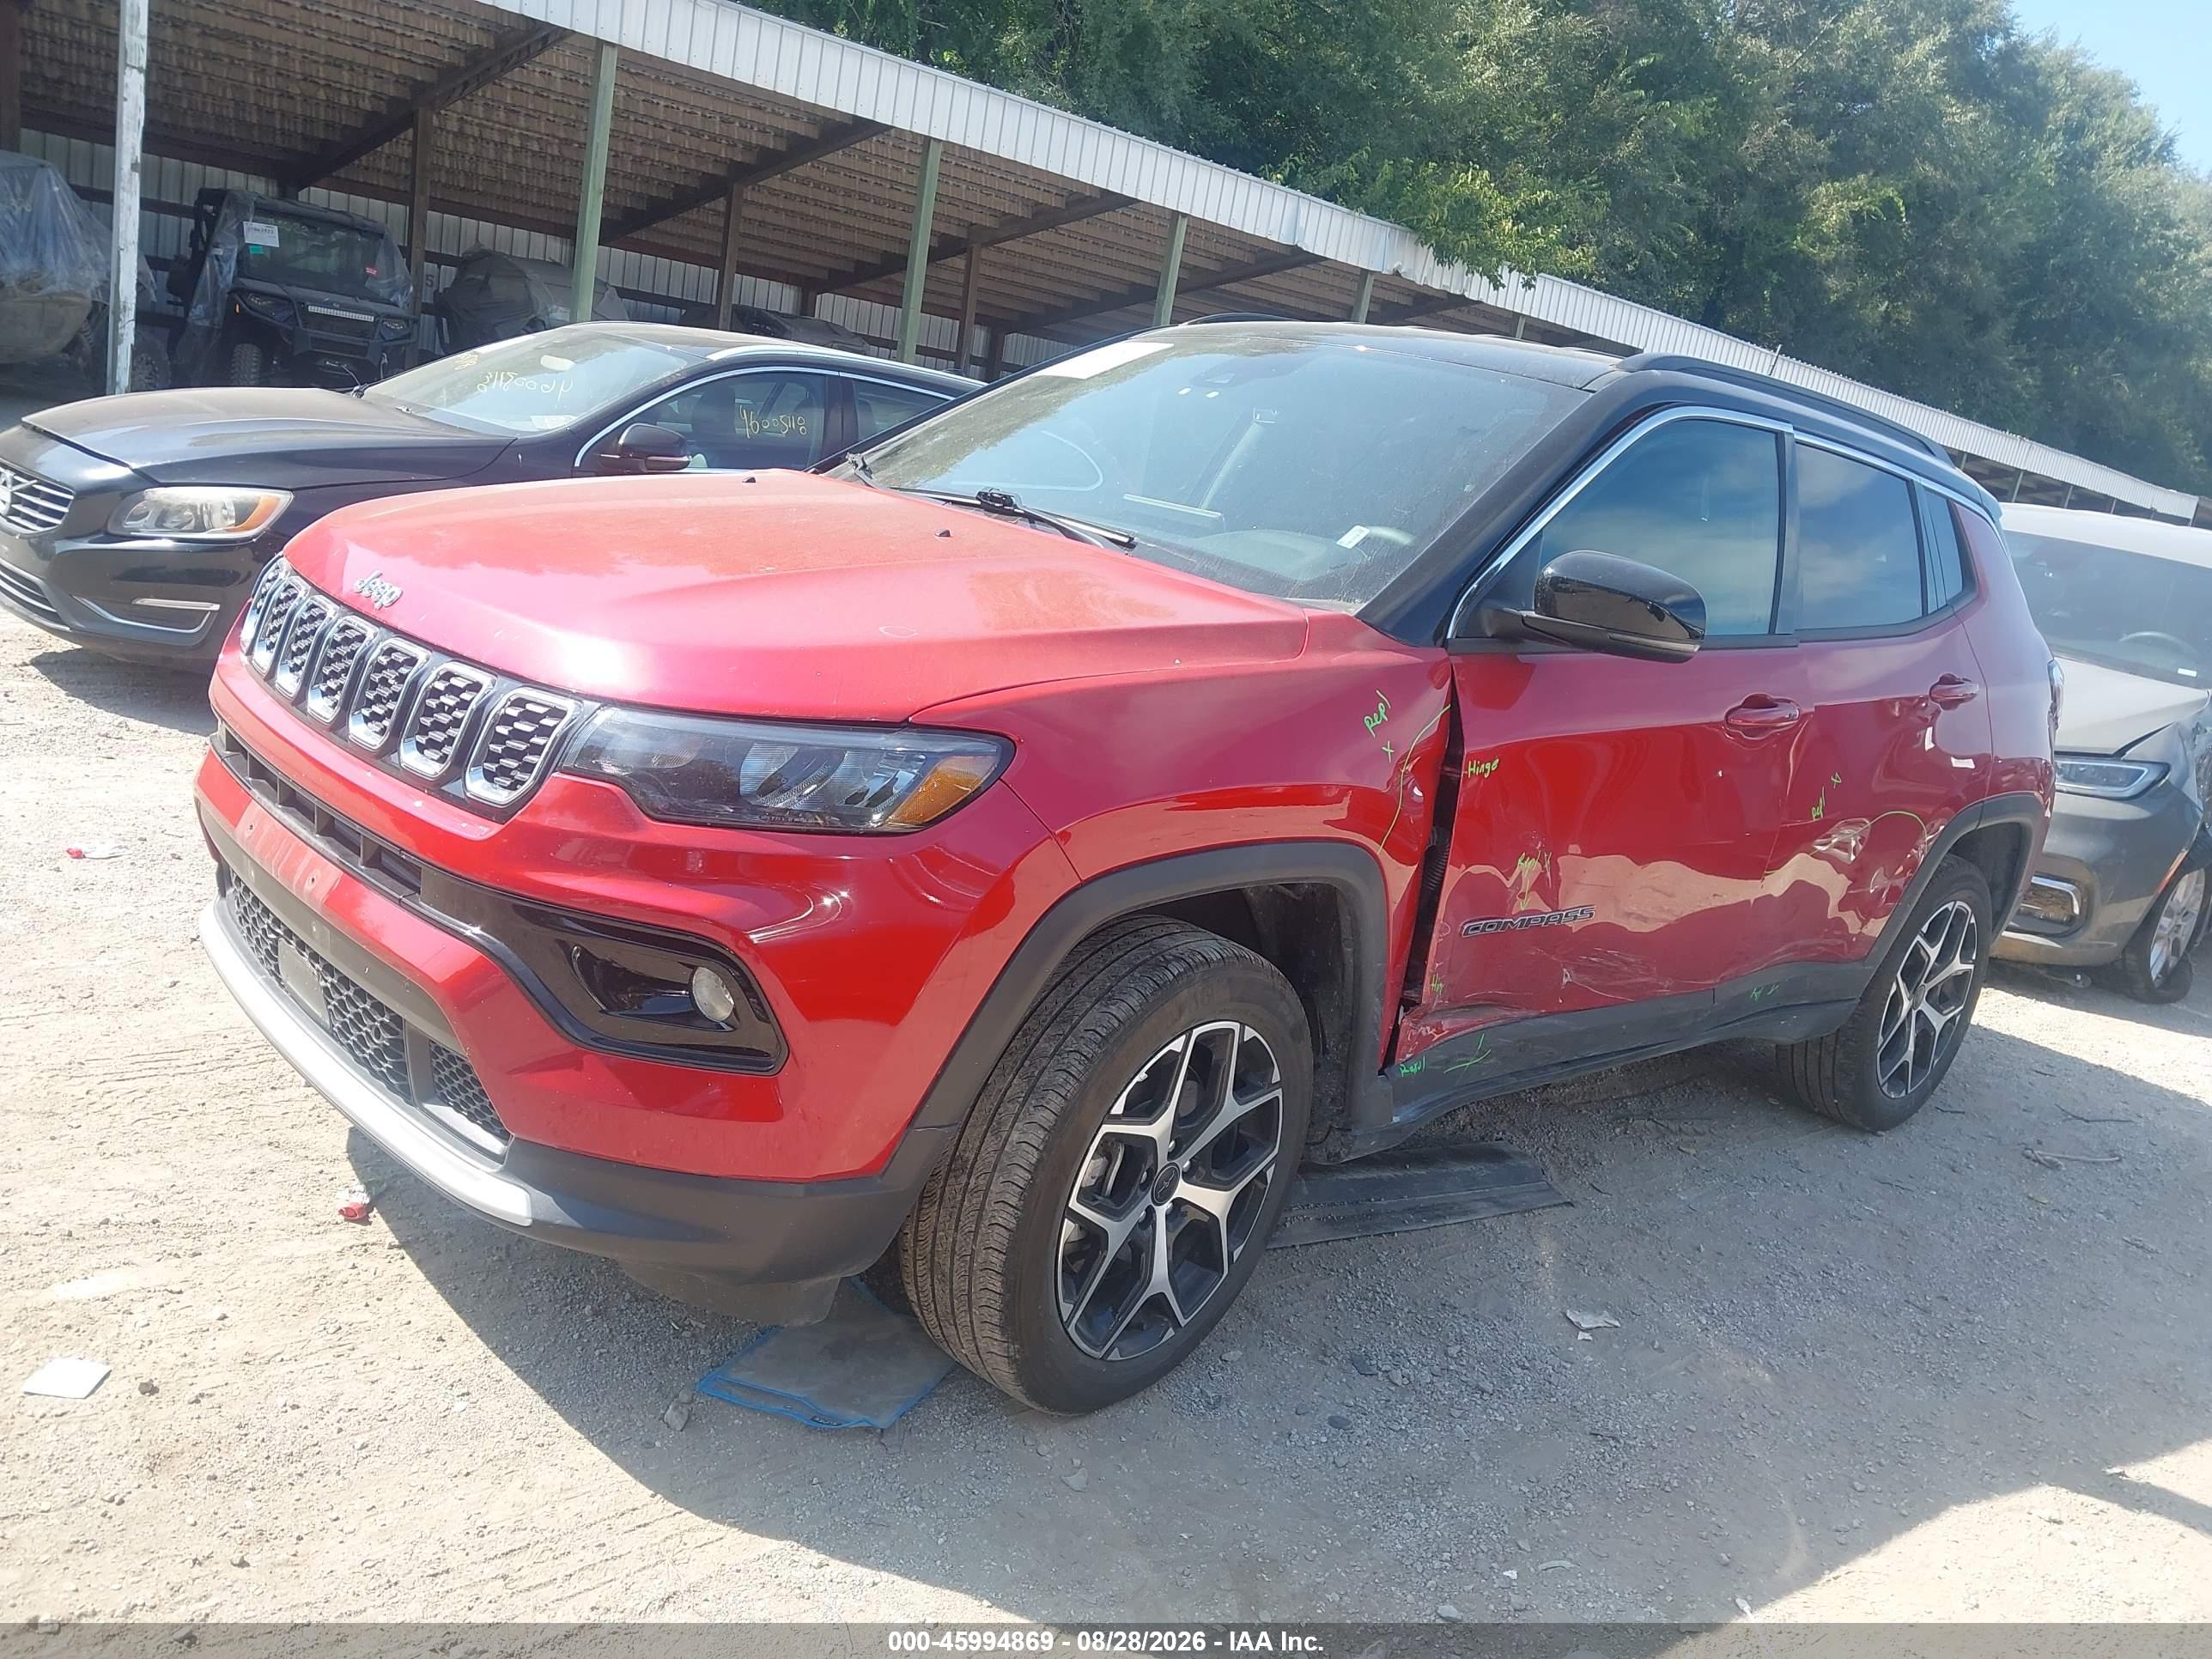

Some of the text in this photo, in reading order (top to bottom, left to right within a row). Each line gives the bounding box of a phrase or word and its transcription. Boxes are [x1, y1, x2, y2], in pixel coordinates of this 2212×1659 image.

[740, 404, 807, 439] 46005118
[353, 569, 404, 611] Jeep
[1468, 758, 1499, 778] Hinge
[1462, 904, 1596, 938] COMPASS
